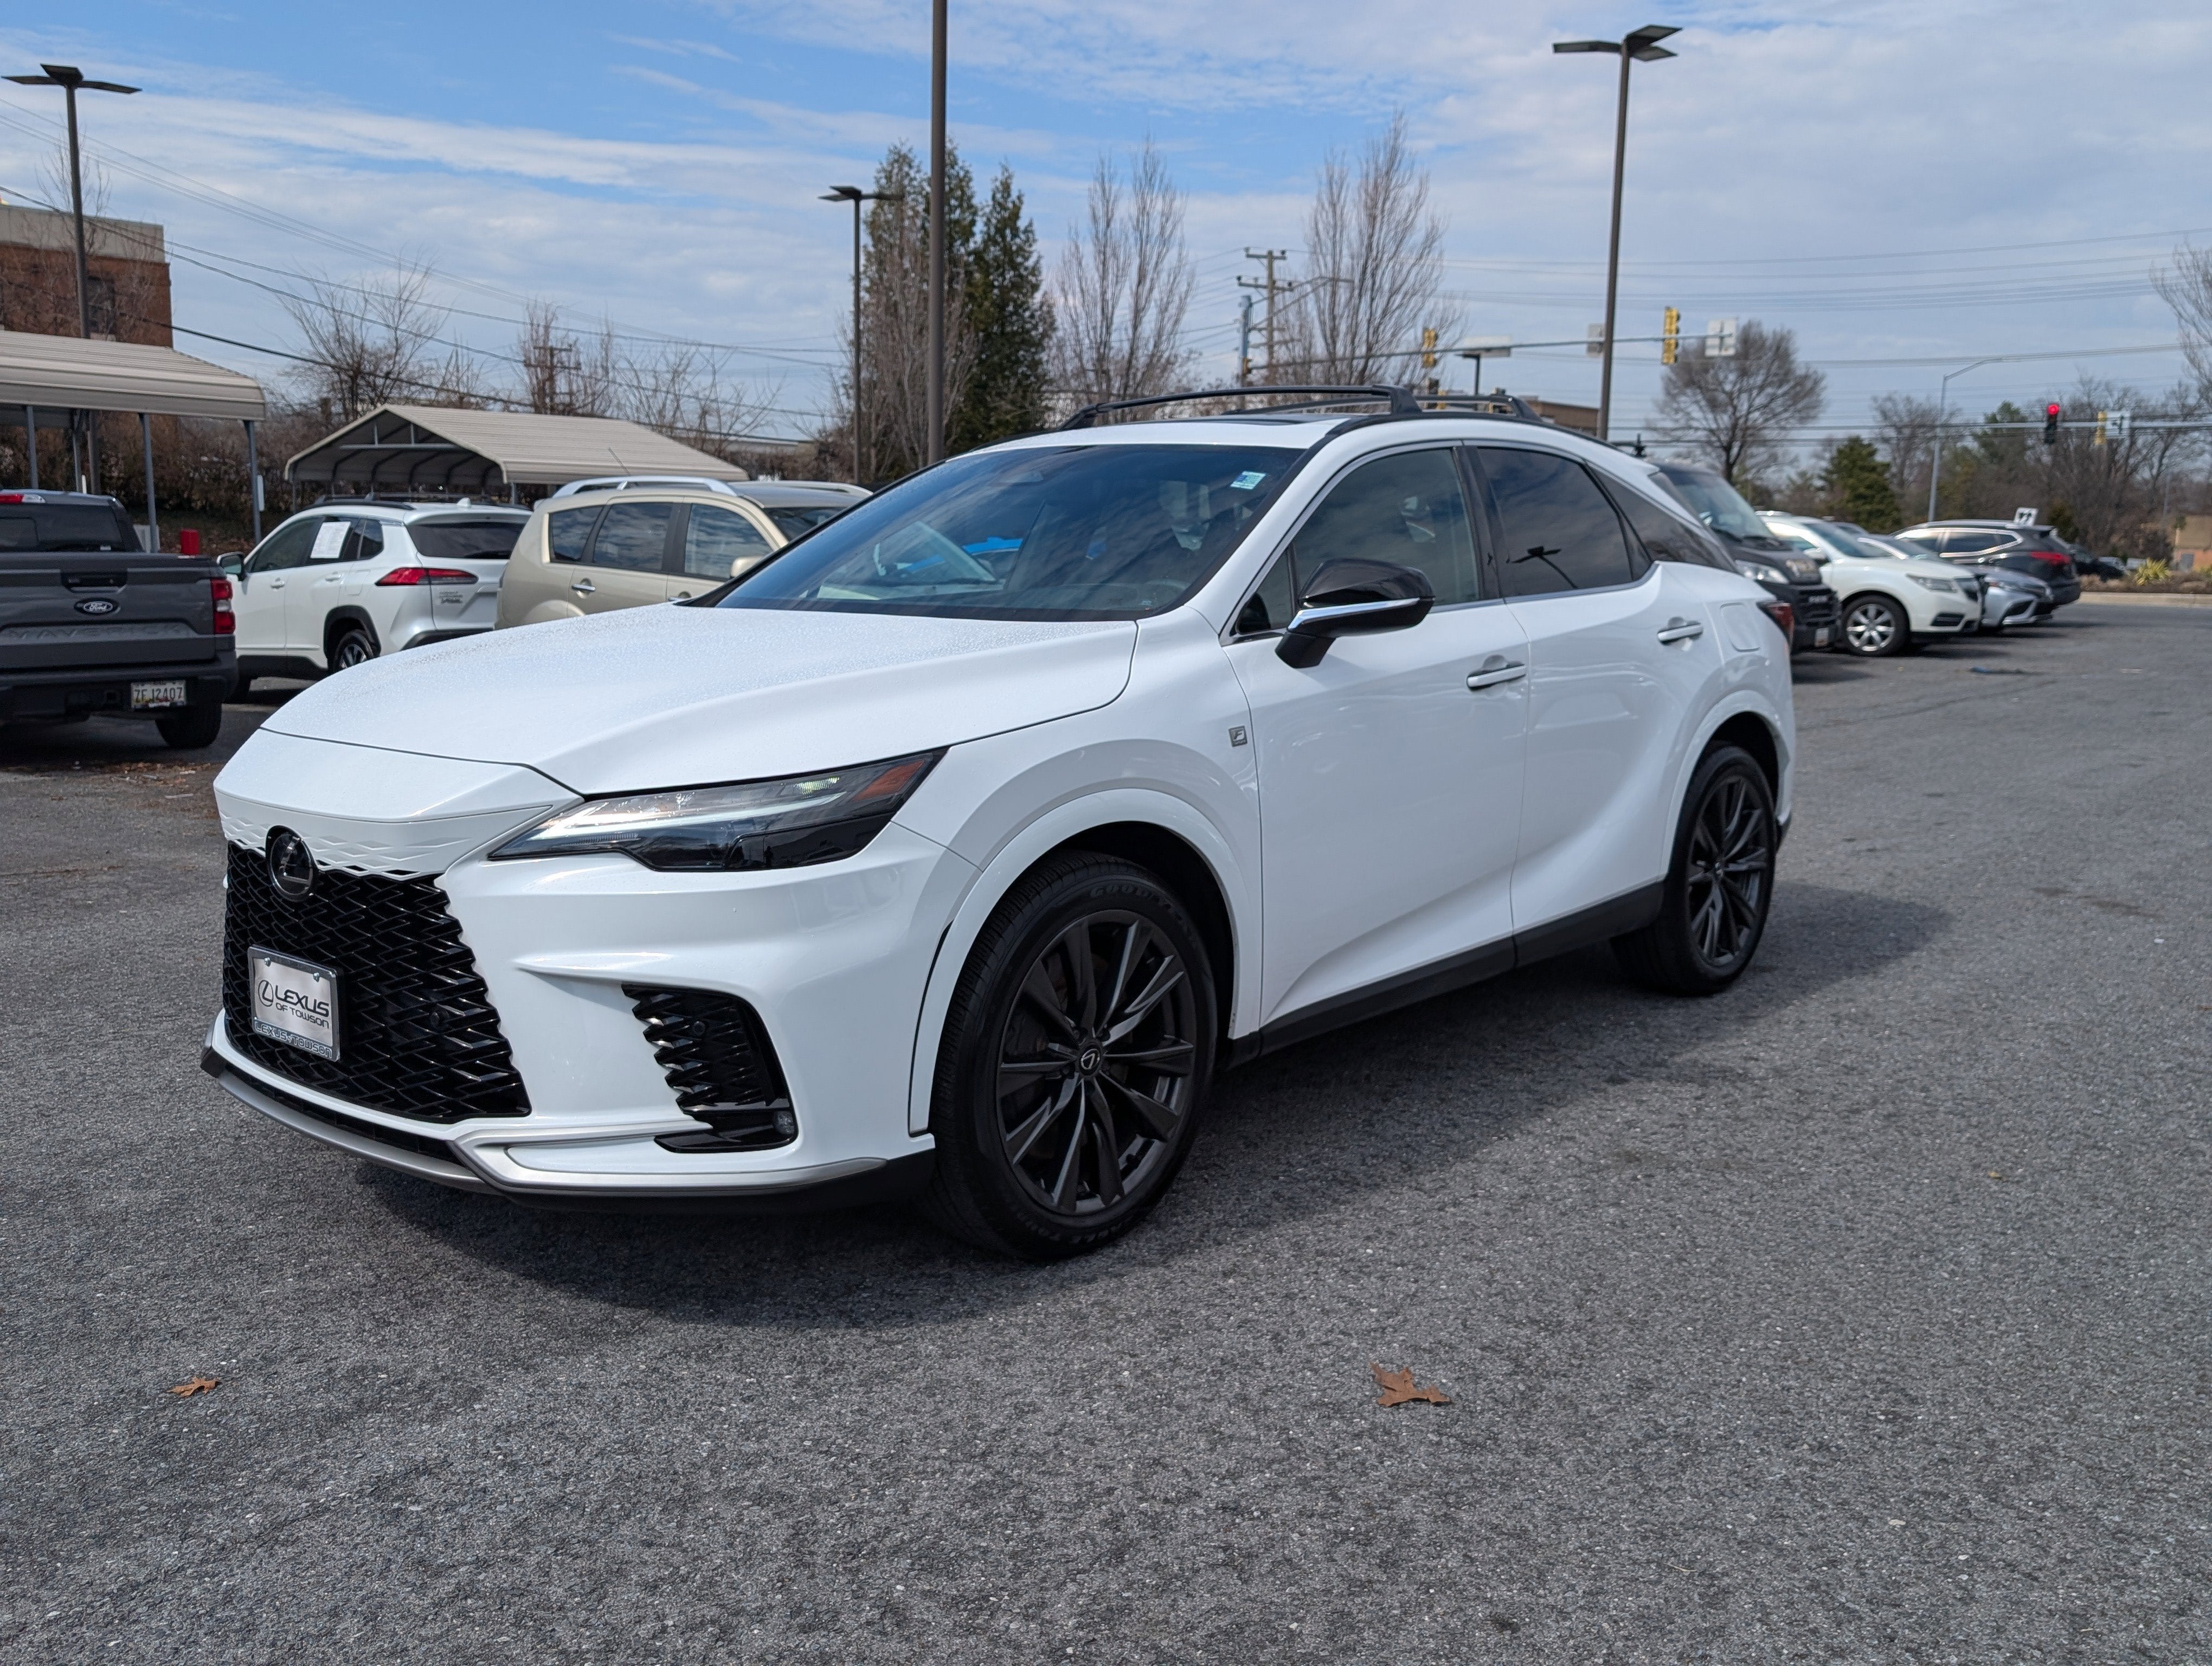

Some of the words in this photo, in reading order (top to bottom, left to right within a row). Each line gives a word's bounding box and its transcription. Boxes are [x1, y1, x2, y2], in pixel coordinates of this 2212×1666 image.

[89, 603, 107, 611] Ford
[275, 985, 330, 1017] LEXUS
[275, 1003, 288, 1011] OF
[291, 1007, 329, 1029] TOWSON
[254, 1021, 287, 1041] LEXUS
[292, 1035, 332, 1059] TOWSON
